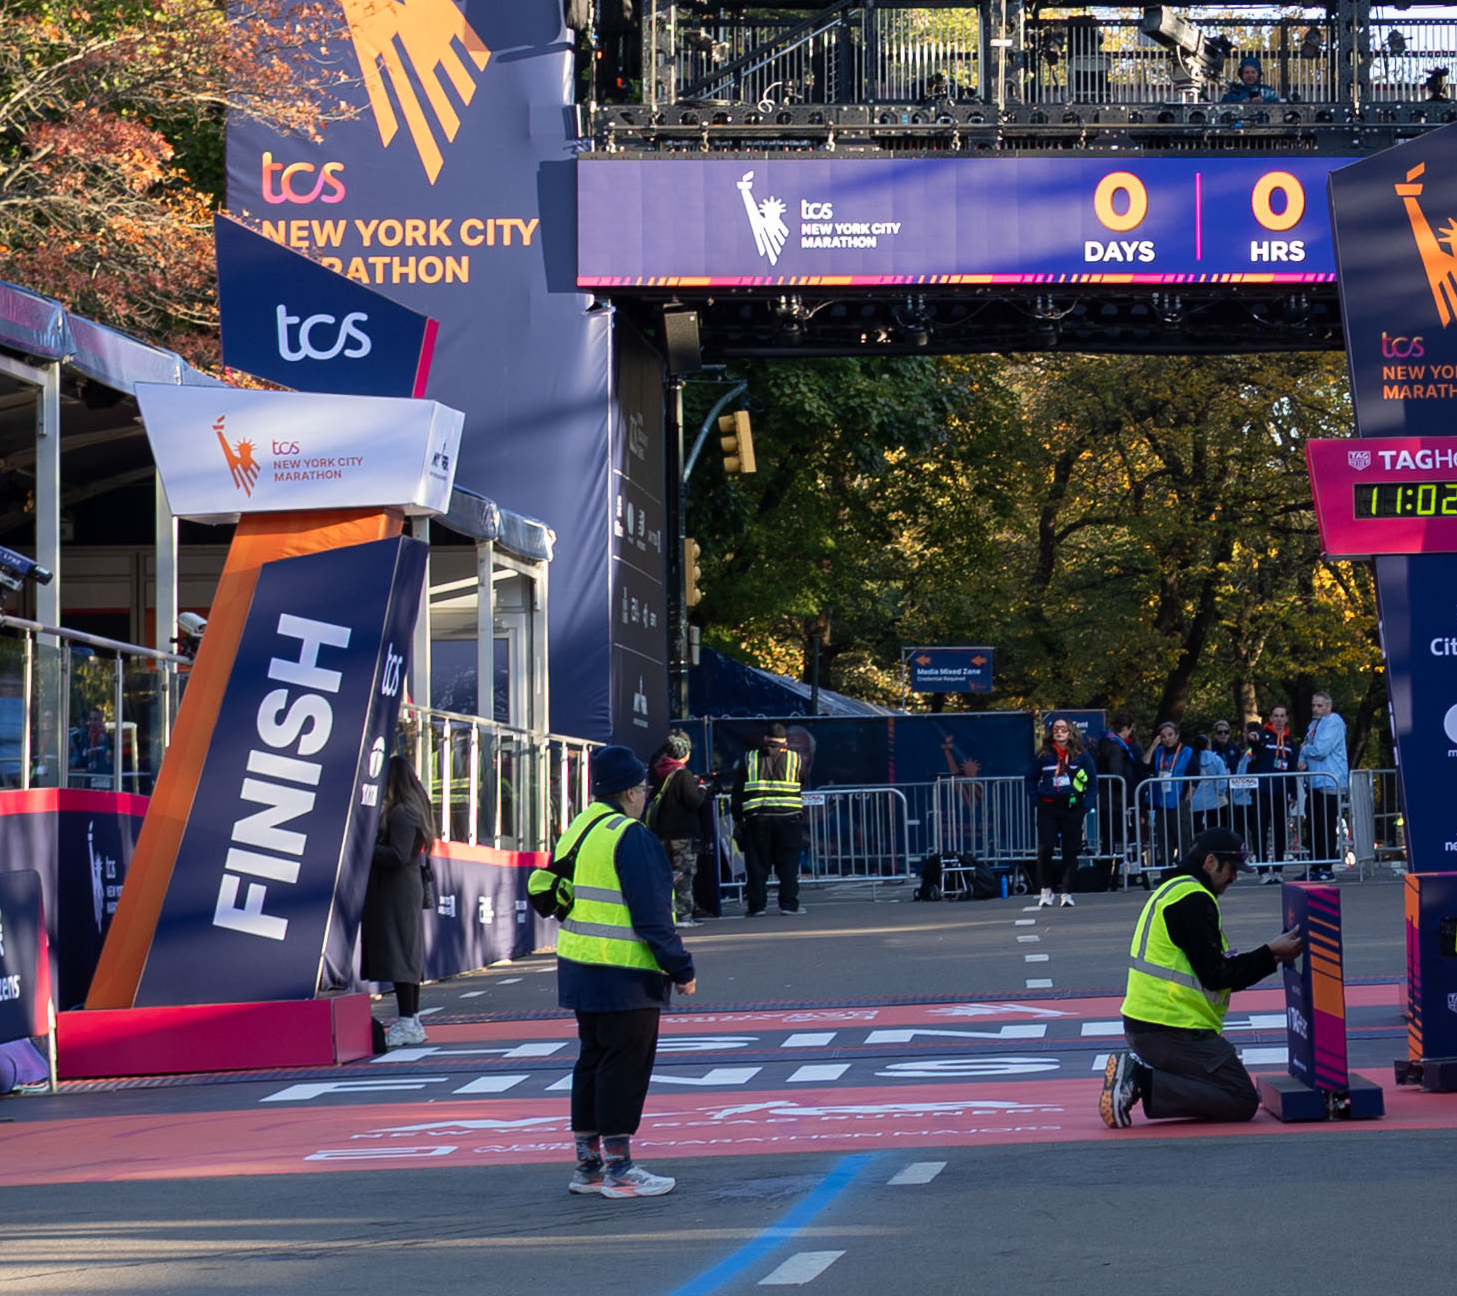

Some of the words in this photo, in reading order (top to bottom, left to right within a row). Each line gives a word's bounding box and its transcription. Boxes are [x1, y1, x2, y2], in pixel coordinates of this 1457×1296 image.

[261, 151, 346, 204] tcs
[800, 199, 833, 220] tcs
[1093, 171, 1148, 231] 0
[1251, 171, 1305, 232] 0
[262, 220, 346, 248] NEW
[354, 219, 452, 247] YORK
[460, 217, 539, 247] CITY
[801, 222, 833, 235] NEW
[834, 222, 869, 235] YORK
[870, 222, 901, 235] CITY
[801, 235, 877, 249] MARATHON
[1083, 240, 1156, 263] DAYS
[1250, 240, 1305, 263] HRS
[322, 256, 470, 285] RATHON
[276, 305, 373, 362] tcs
[1381, 331, 1425, 358] tcs
[1382, 365, 1425, 381] NEW
[272, 438, 301, 456] tcs
[273, 460, 302, 471] NEW
[305, 458, 336, 469] YORK
[338, 457, 363, 468] CITY
[274, 469, 343, 482] MARATHON
[381, 642, 403, 697] tcs
[213, 613, 352, 941] FINISH
